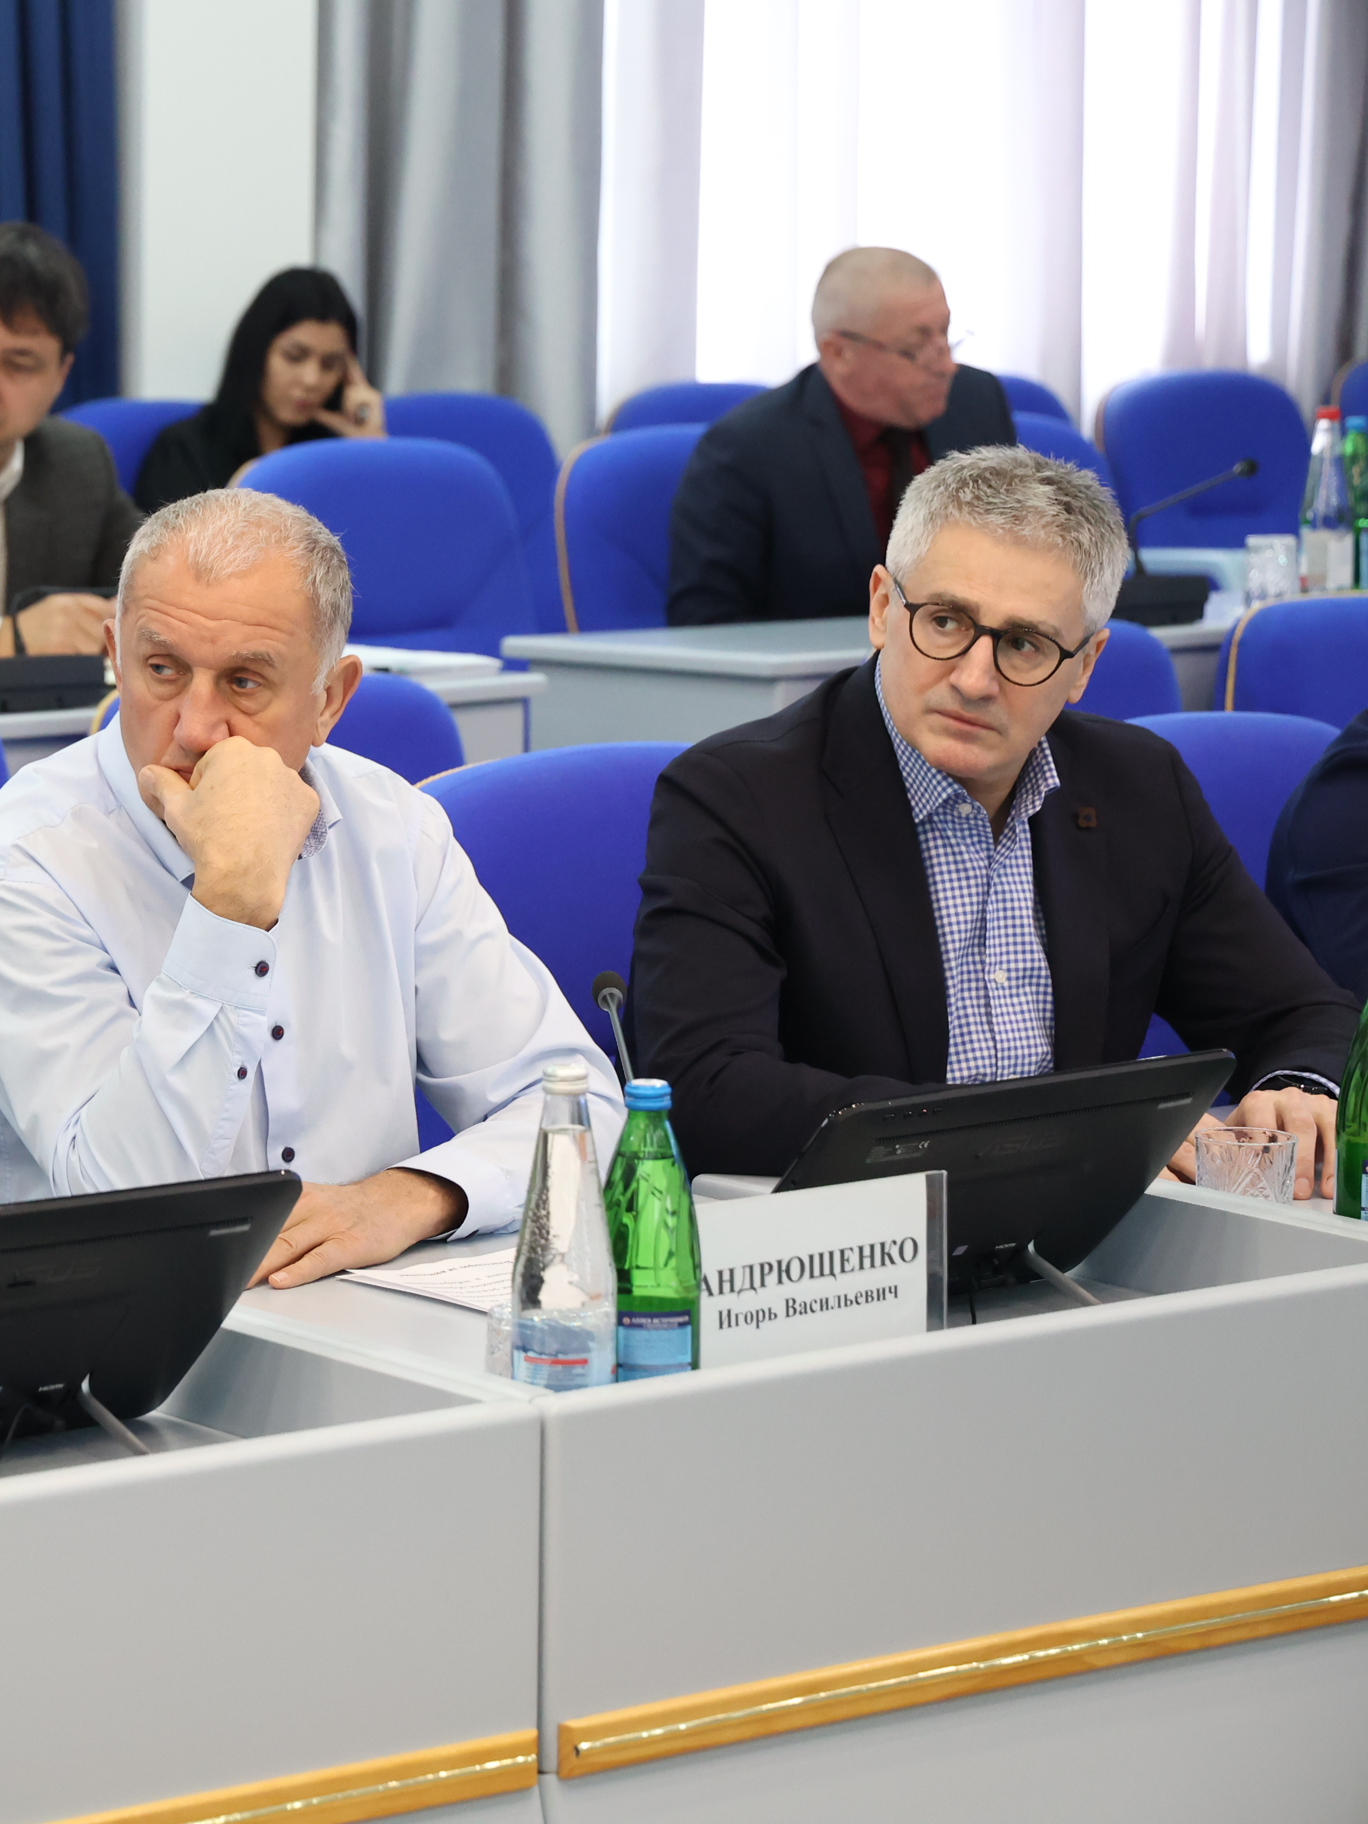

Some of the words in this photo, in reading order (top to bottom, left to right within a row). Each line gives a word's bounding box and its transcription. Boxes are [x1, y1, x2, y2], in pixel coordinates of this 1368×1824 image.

[700, 1236, 919, 1299] АНДРЮЩЕНКО
[717, 1304, 778, 1330] Игорь
[784, 1284, 899, 1319] Васильевич
